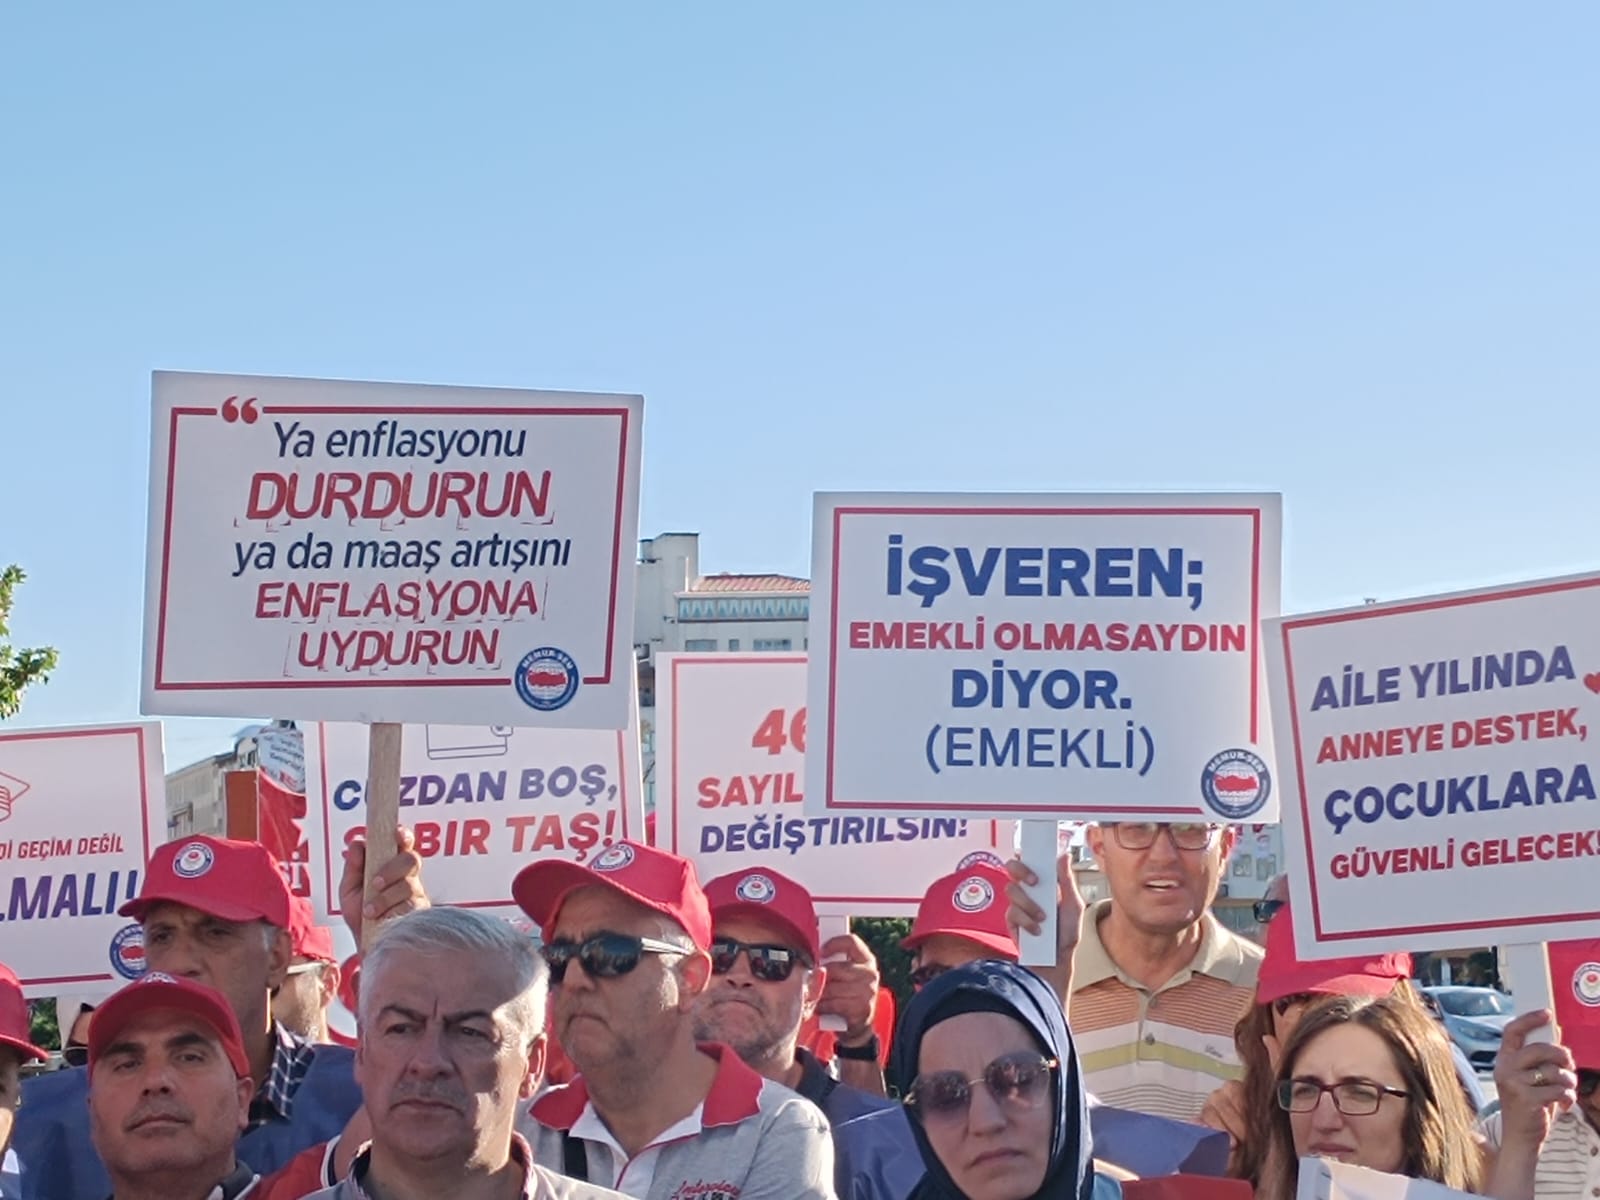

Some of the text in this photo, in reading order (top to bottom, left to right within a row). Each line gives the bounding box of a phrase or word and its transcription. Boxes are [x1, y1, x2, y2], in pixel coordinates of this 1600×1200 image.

[273, 421, 526, 465] Ya enflasyonu
[247, 471, 552, 520] DURDURUN
[232, 532, 571, 577] ya da maaş artışını
[887, 534, 1203, 611] İŞVEREN;
[255, 579, 538, 619] ENFLASYONA
[299, 629, 500, 668] UYDURUN
[849, 616, 1246, 652] EMEKLİ OLMASAYDIN
[951, 659, 1132, 710] DİYOR.
[1310, 645, 1577, 712] AİLE YILINDA
[926, 720, 1155, 777] (EMEKLİ)
[1316, 707, 1588, 764] ANNEYE DESTEK,
[333, 764, 618, 811] CZDAN BOŞ,
[1324, 764, 1597, 834] ÇOCUKLARA
[17, 836, 73, 861] GEÇİM
[77, 832, 124, 856] DEĞİL
[506, 810, 617, 862] TAŞ!
[1330, 838, 1455, 879] GÜVENLİ
[0, 869, 138, 921] MALI!
